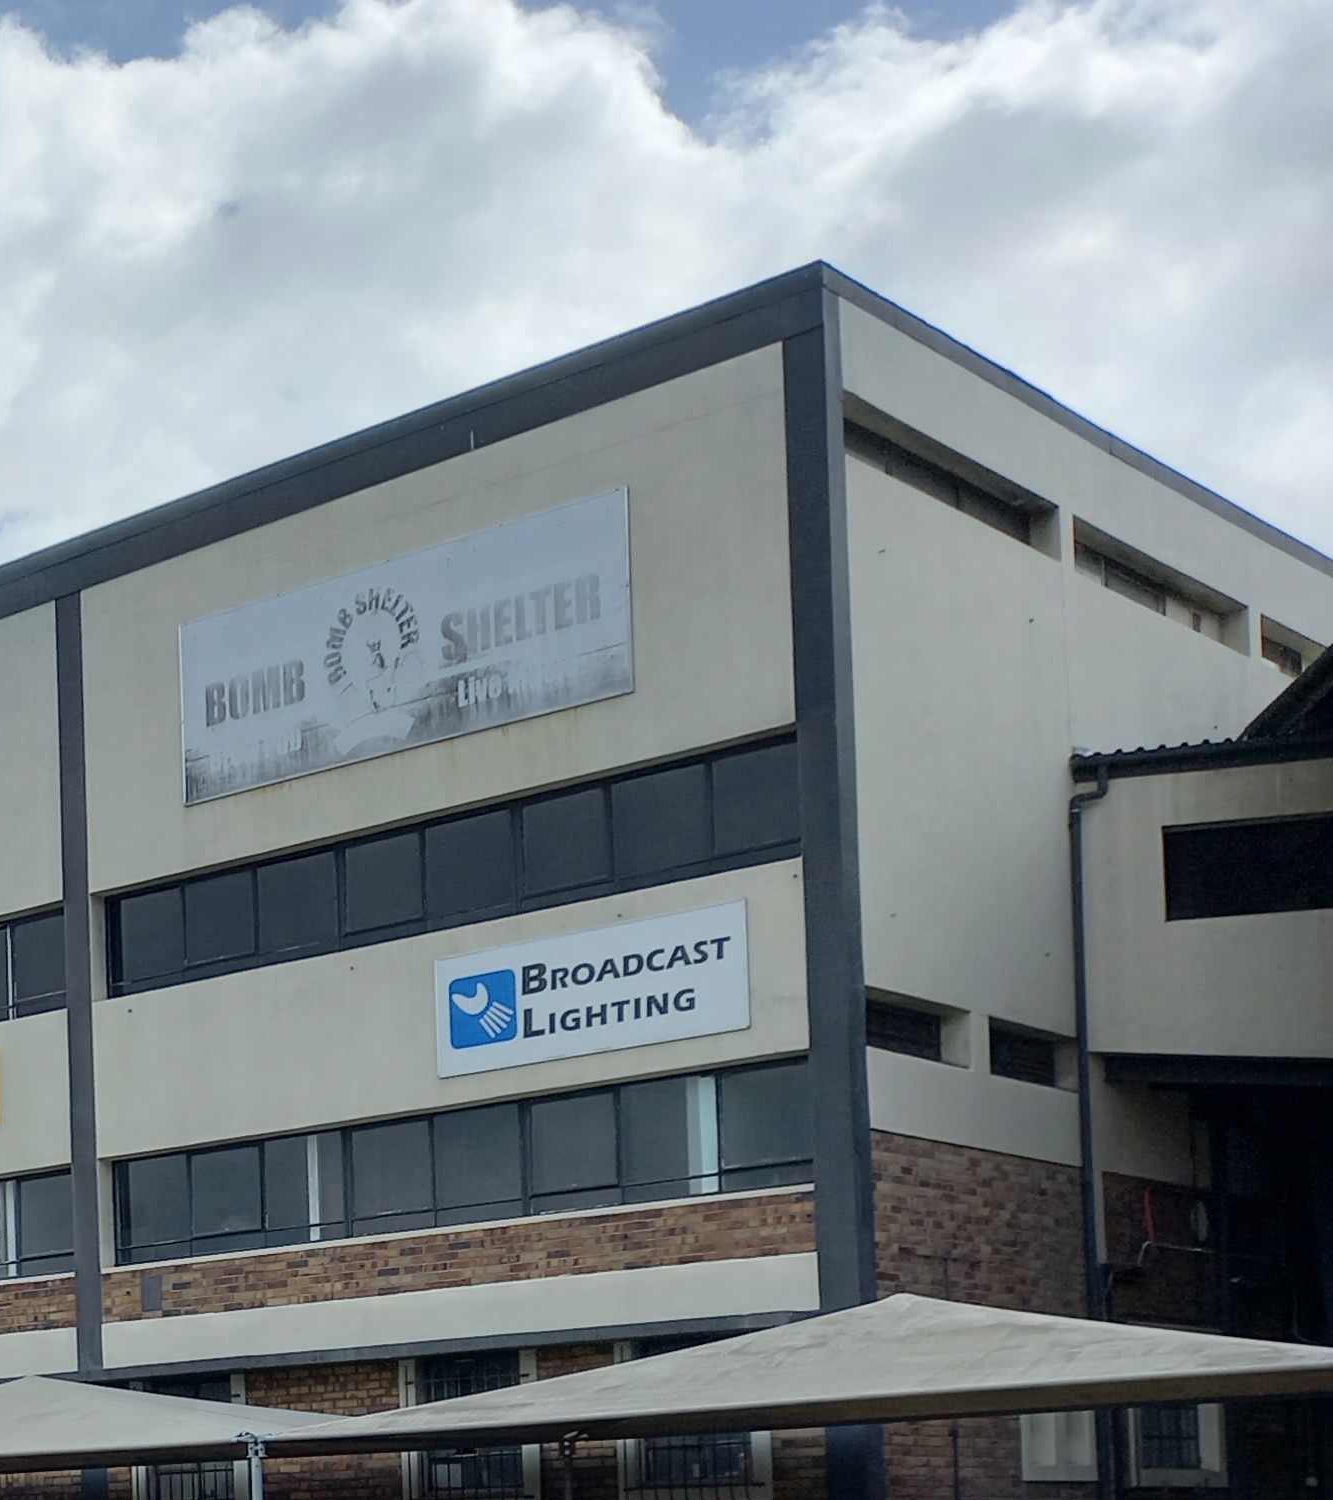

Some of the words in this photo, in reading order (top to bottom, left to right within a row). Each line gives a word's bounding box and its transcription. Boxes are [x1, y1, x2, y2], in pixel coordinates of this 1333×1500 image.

[205, 659, 305, 728] BOMB
[440, 573, 602, 666] SHELTER
[521, 936, 732, 996] BROADCAST
[523, 988, 697, 1039] LIGHTING
